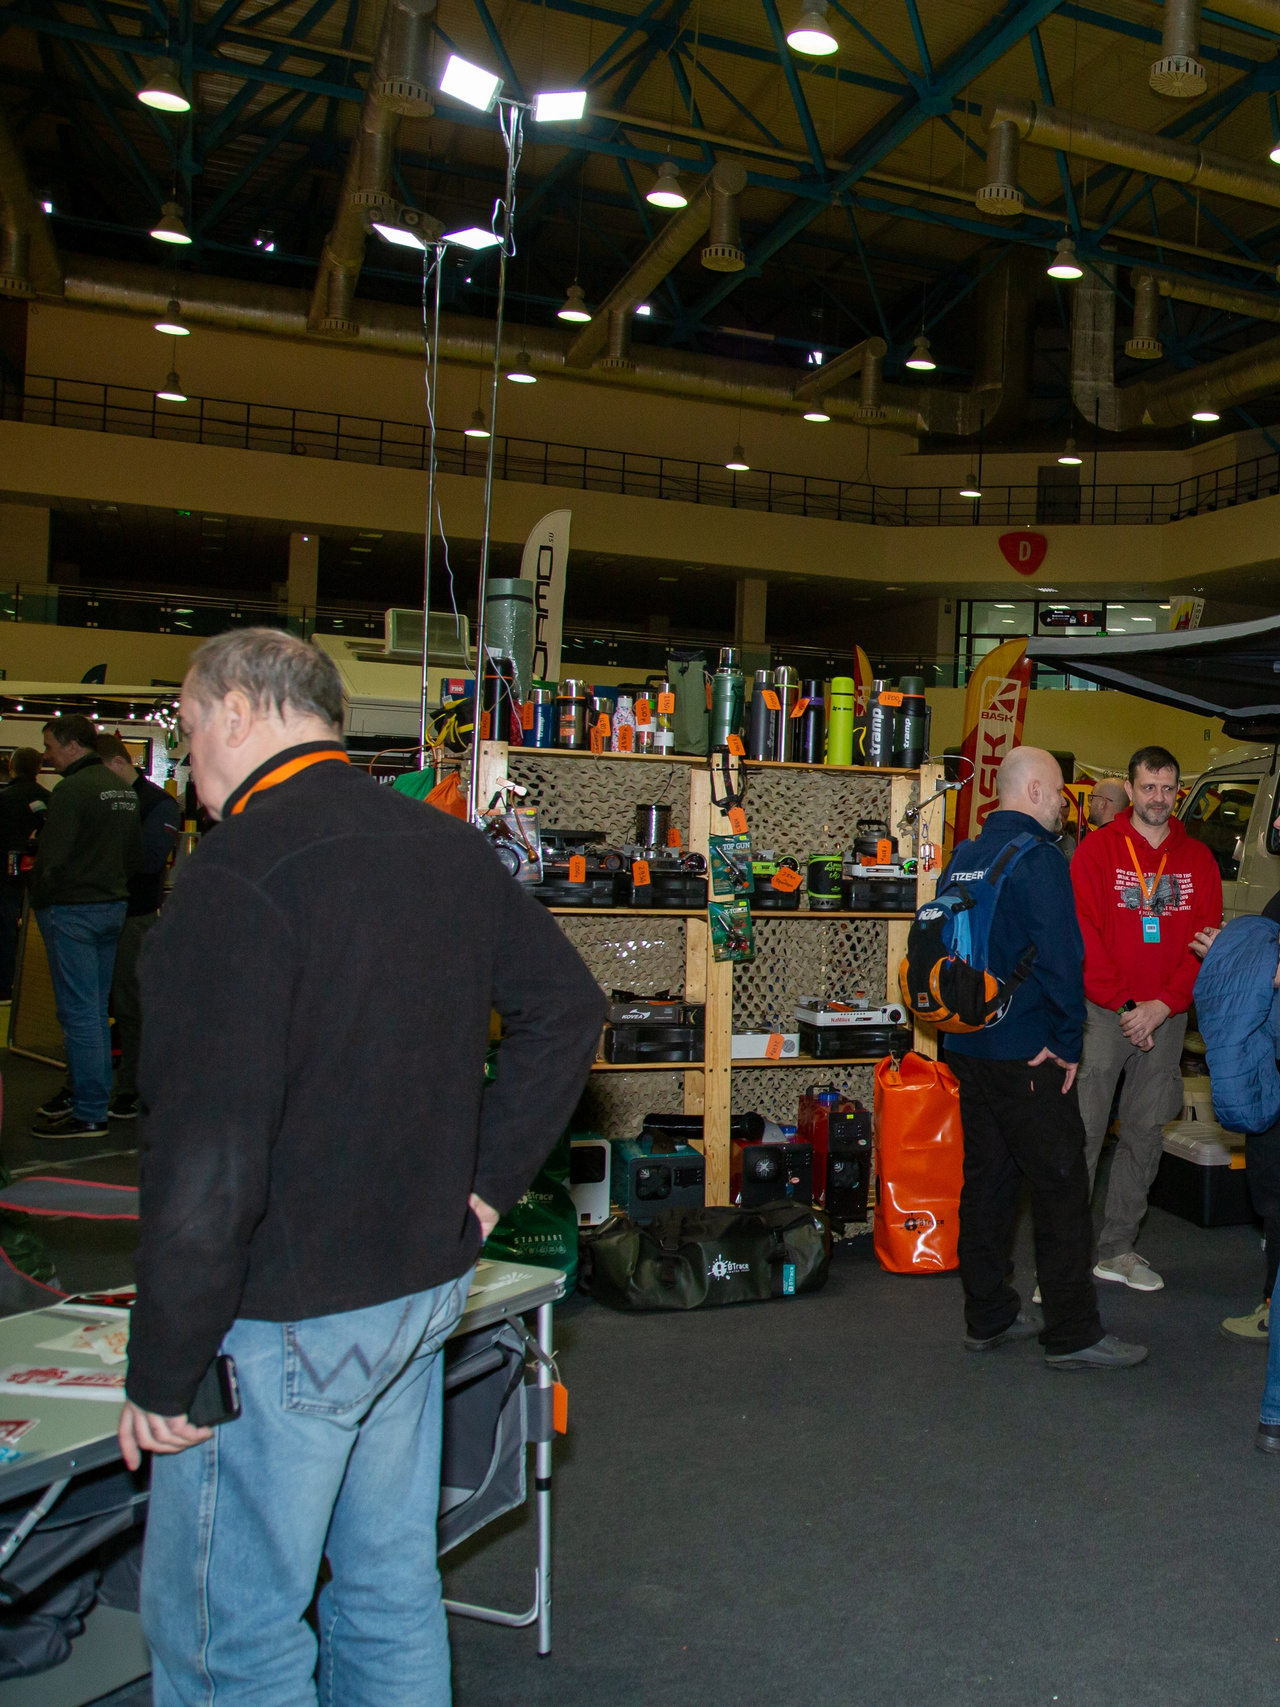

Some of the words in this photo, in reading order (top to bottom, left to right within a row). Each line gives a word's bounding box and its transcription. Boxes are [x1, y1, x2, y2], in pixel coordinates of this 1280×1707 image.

[1019, 540, 1032, 562] D
[1082, 613, 1089, 623] 1
[981, 711, 1014, 723] BASK
[870, 708, 885, 756] tramp
[903, 717, 912, 749] tramp
[975, 731, 1007, 840] ASK
[918, 908, 944, 920] KTM
[514, 1234, 562, 1245] STANDART
